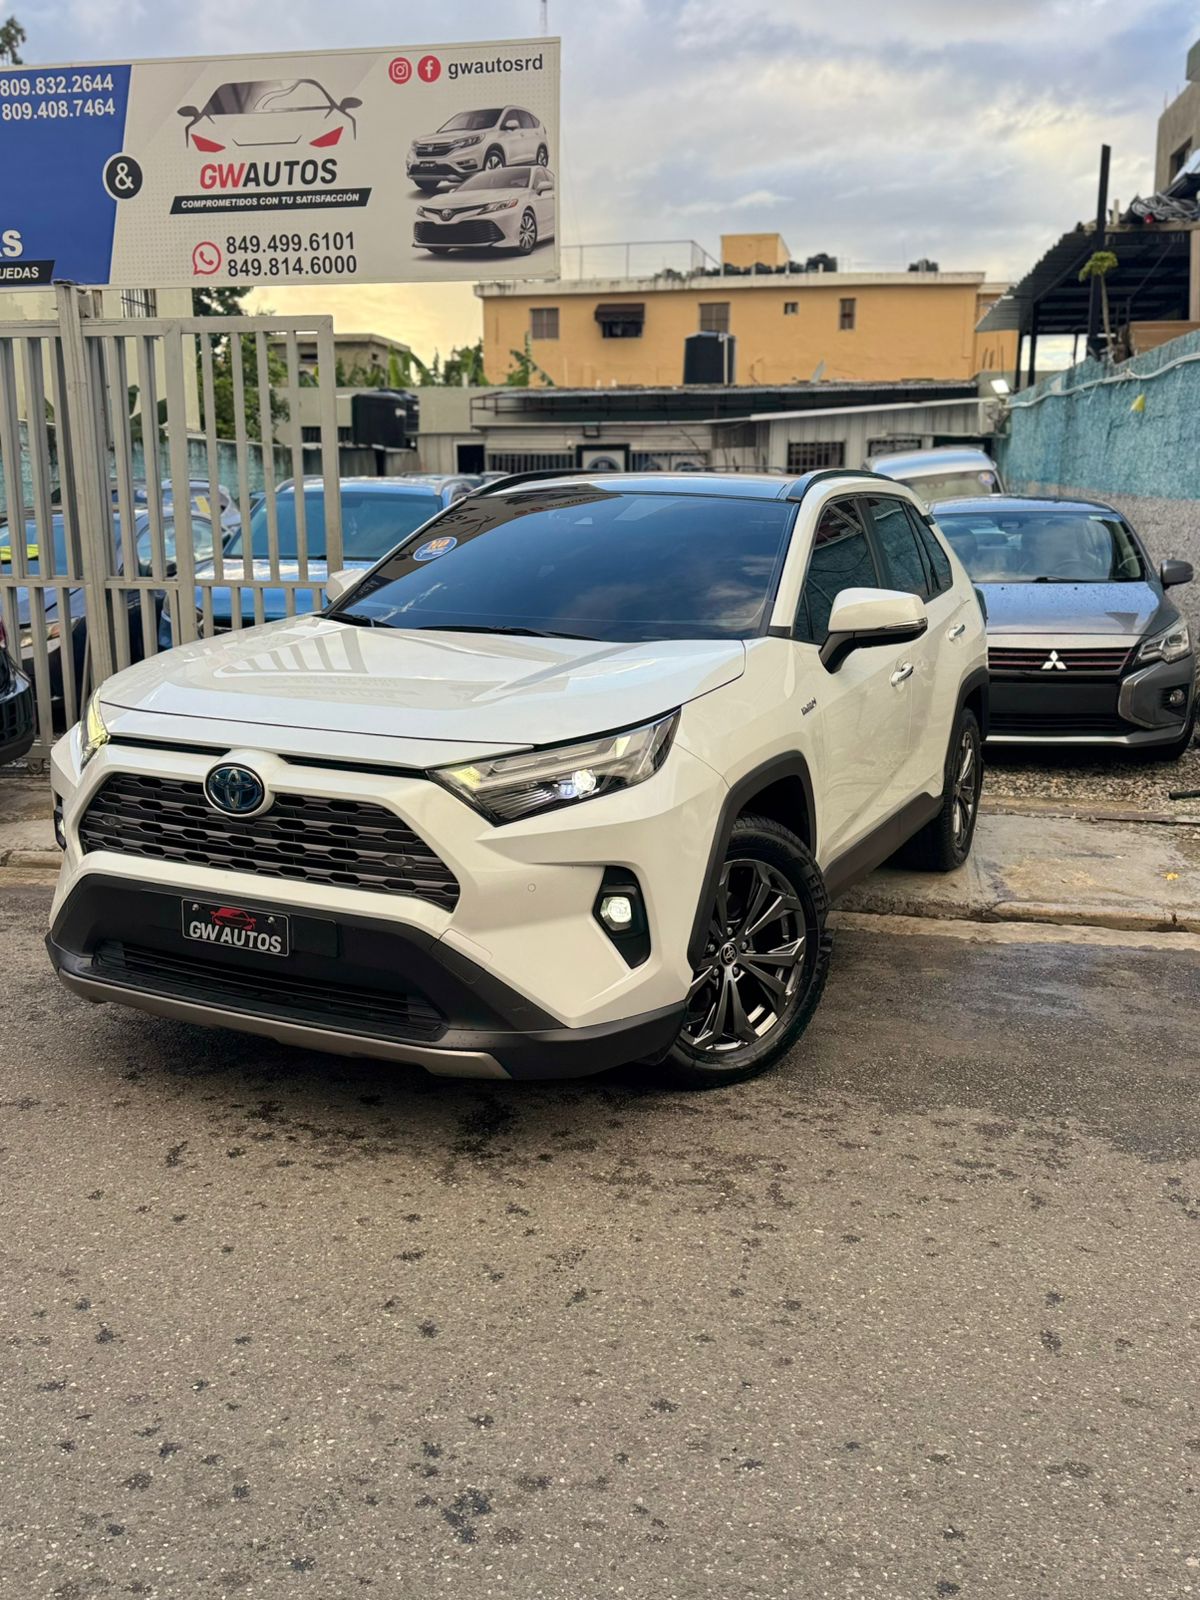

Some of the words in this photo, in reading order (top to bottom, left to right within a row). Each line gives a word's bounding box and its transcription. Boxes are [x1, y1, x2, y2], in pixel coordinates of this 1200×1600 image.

[448, 54, 543, 79] gwautosrd
[0, 73, 114, 96] 809.832.2644
[2, 98, 115, 120] 809.408.7464
[114, 163, 134, 190] &
[200, 158, 337, 189] GWAUTOS
[181, 198, 257, 209] COMPROMETIDOS
[260, 197, 279, 205] CON
[282, 196, 293, 204] TU
[295, 192, 359, 204] SATISFACCIÓN
[0, 229, 23, 257] S
[226, 231, 354, 254] 849.499.6101
[228, 255, 357, 277] 849.814.6000
[189, 921, 220, 940] GW
[220, 926, 282, 953] AUTOS
